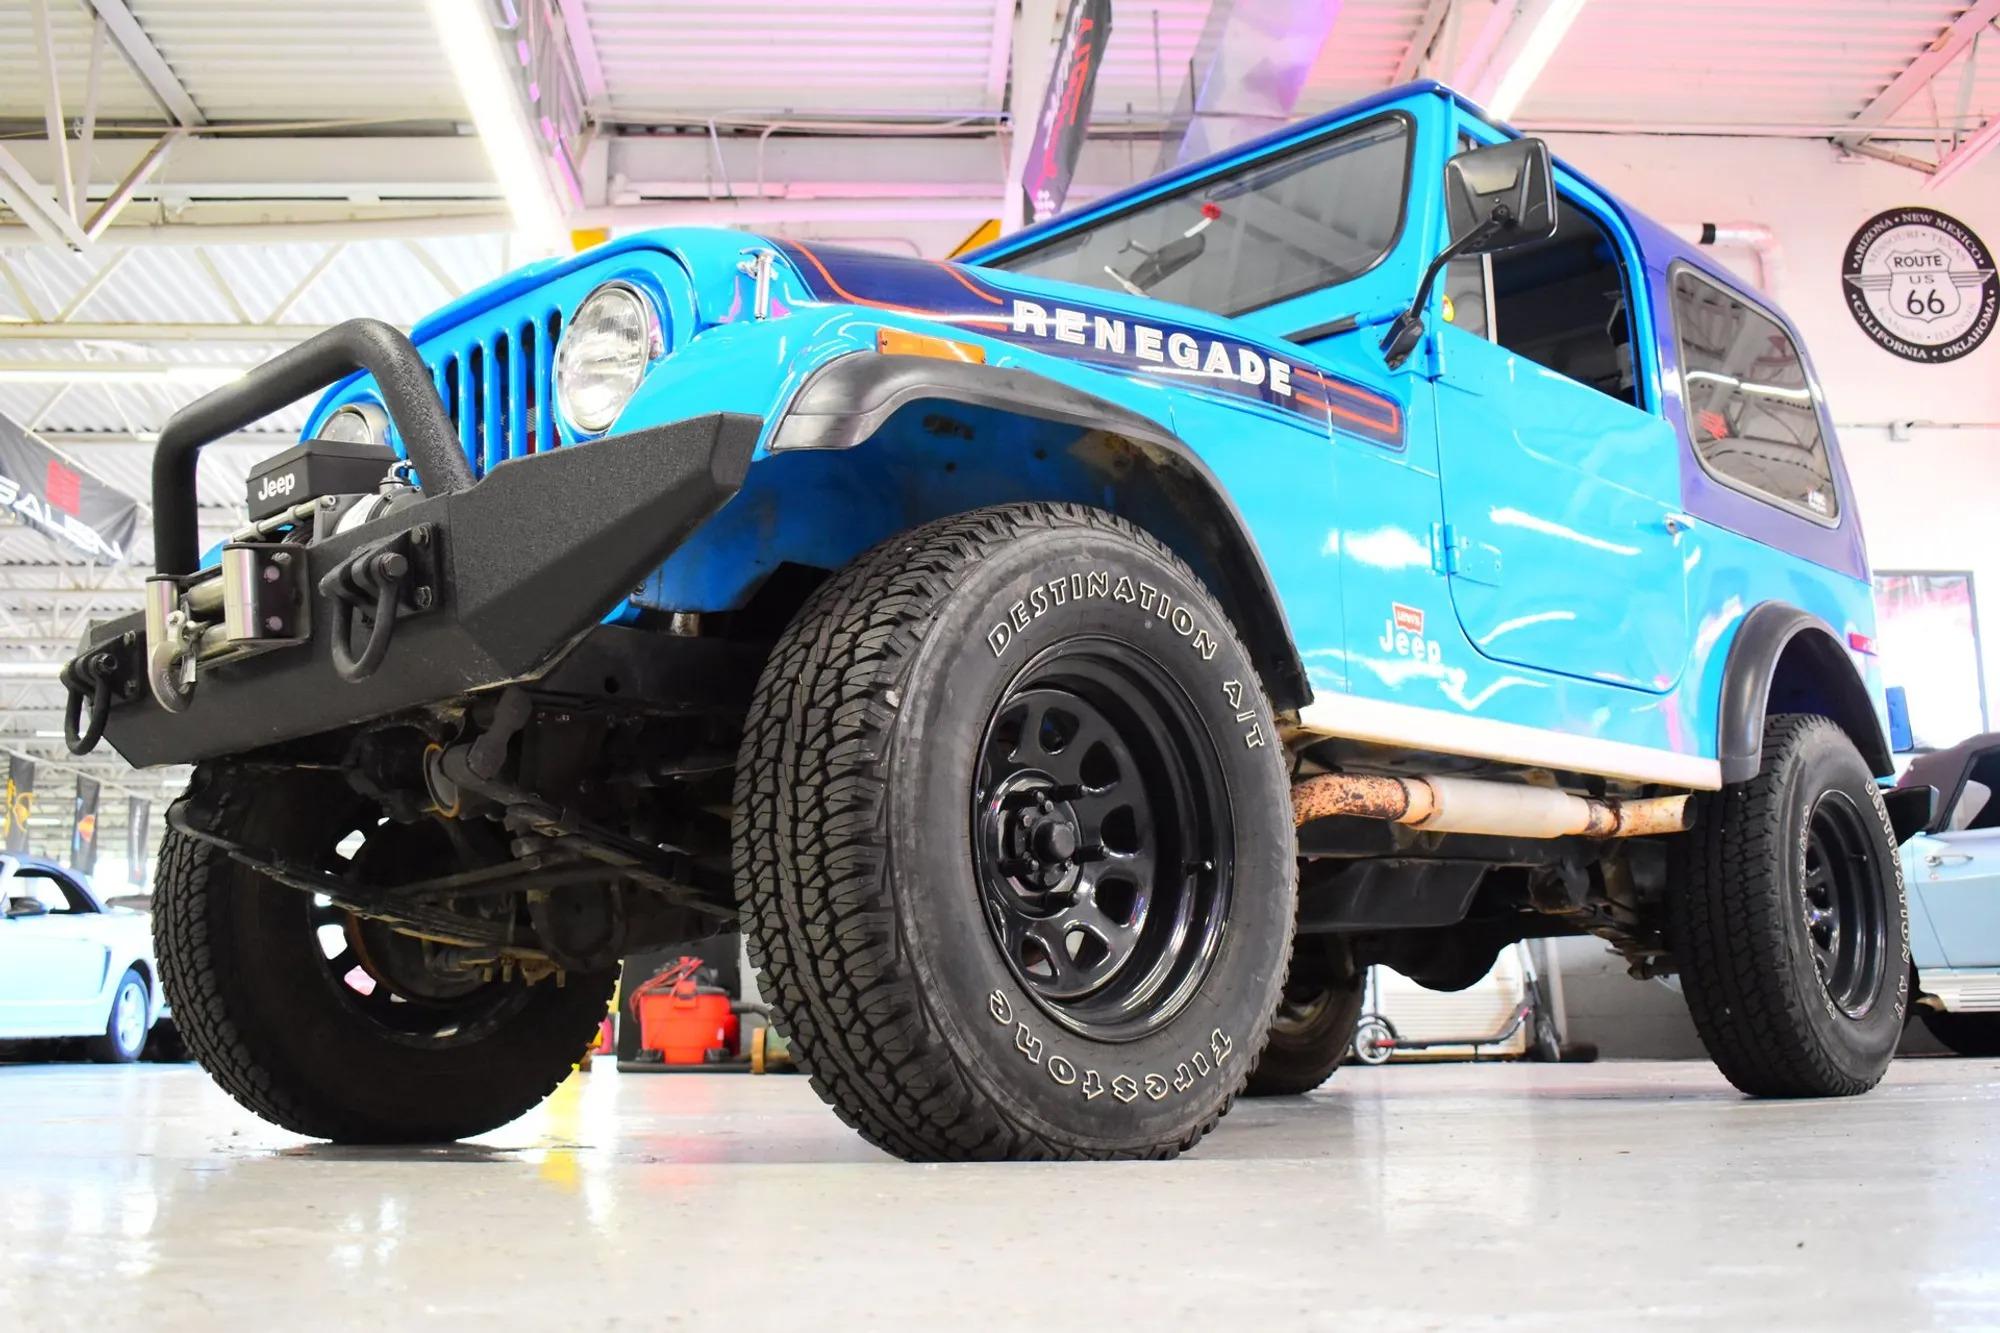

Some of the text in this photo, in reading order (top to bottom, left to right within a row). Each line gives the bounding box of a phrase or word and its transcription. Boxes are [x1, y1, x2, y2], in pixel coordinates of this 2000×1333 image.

[1853, 213, 1983, 265] ARIZONA NEW MEXICO
[1894, 255, 1943, 268] ROUTE
[1907, 289, 1945, 315] 66
[1909, 274, 1935, 285] US
[1012, 299, 1294, 397] RENEGADE
[1853, 297, 1997, 360] CALIFORNIA OKLAHOMA
[258, 472, 296, 501] Jeep
[987, 570, 1218, 661] DESTINATION
[1379, 618, 1441, 666] Jeep
[1865, 777, 1911, 965] DESTINATION
[989, 988, 1233, 1103] Firestone
